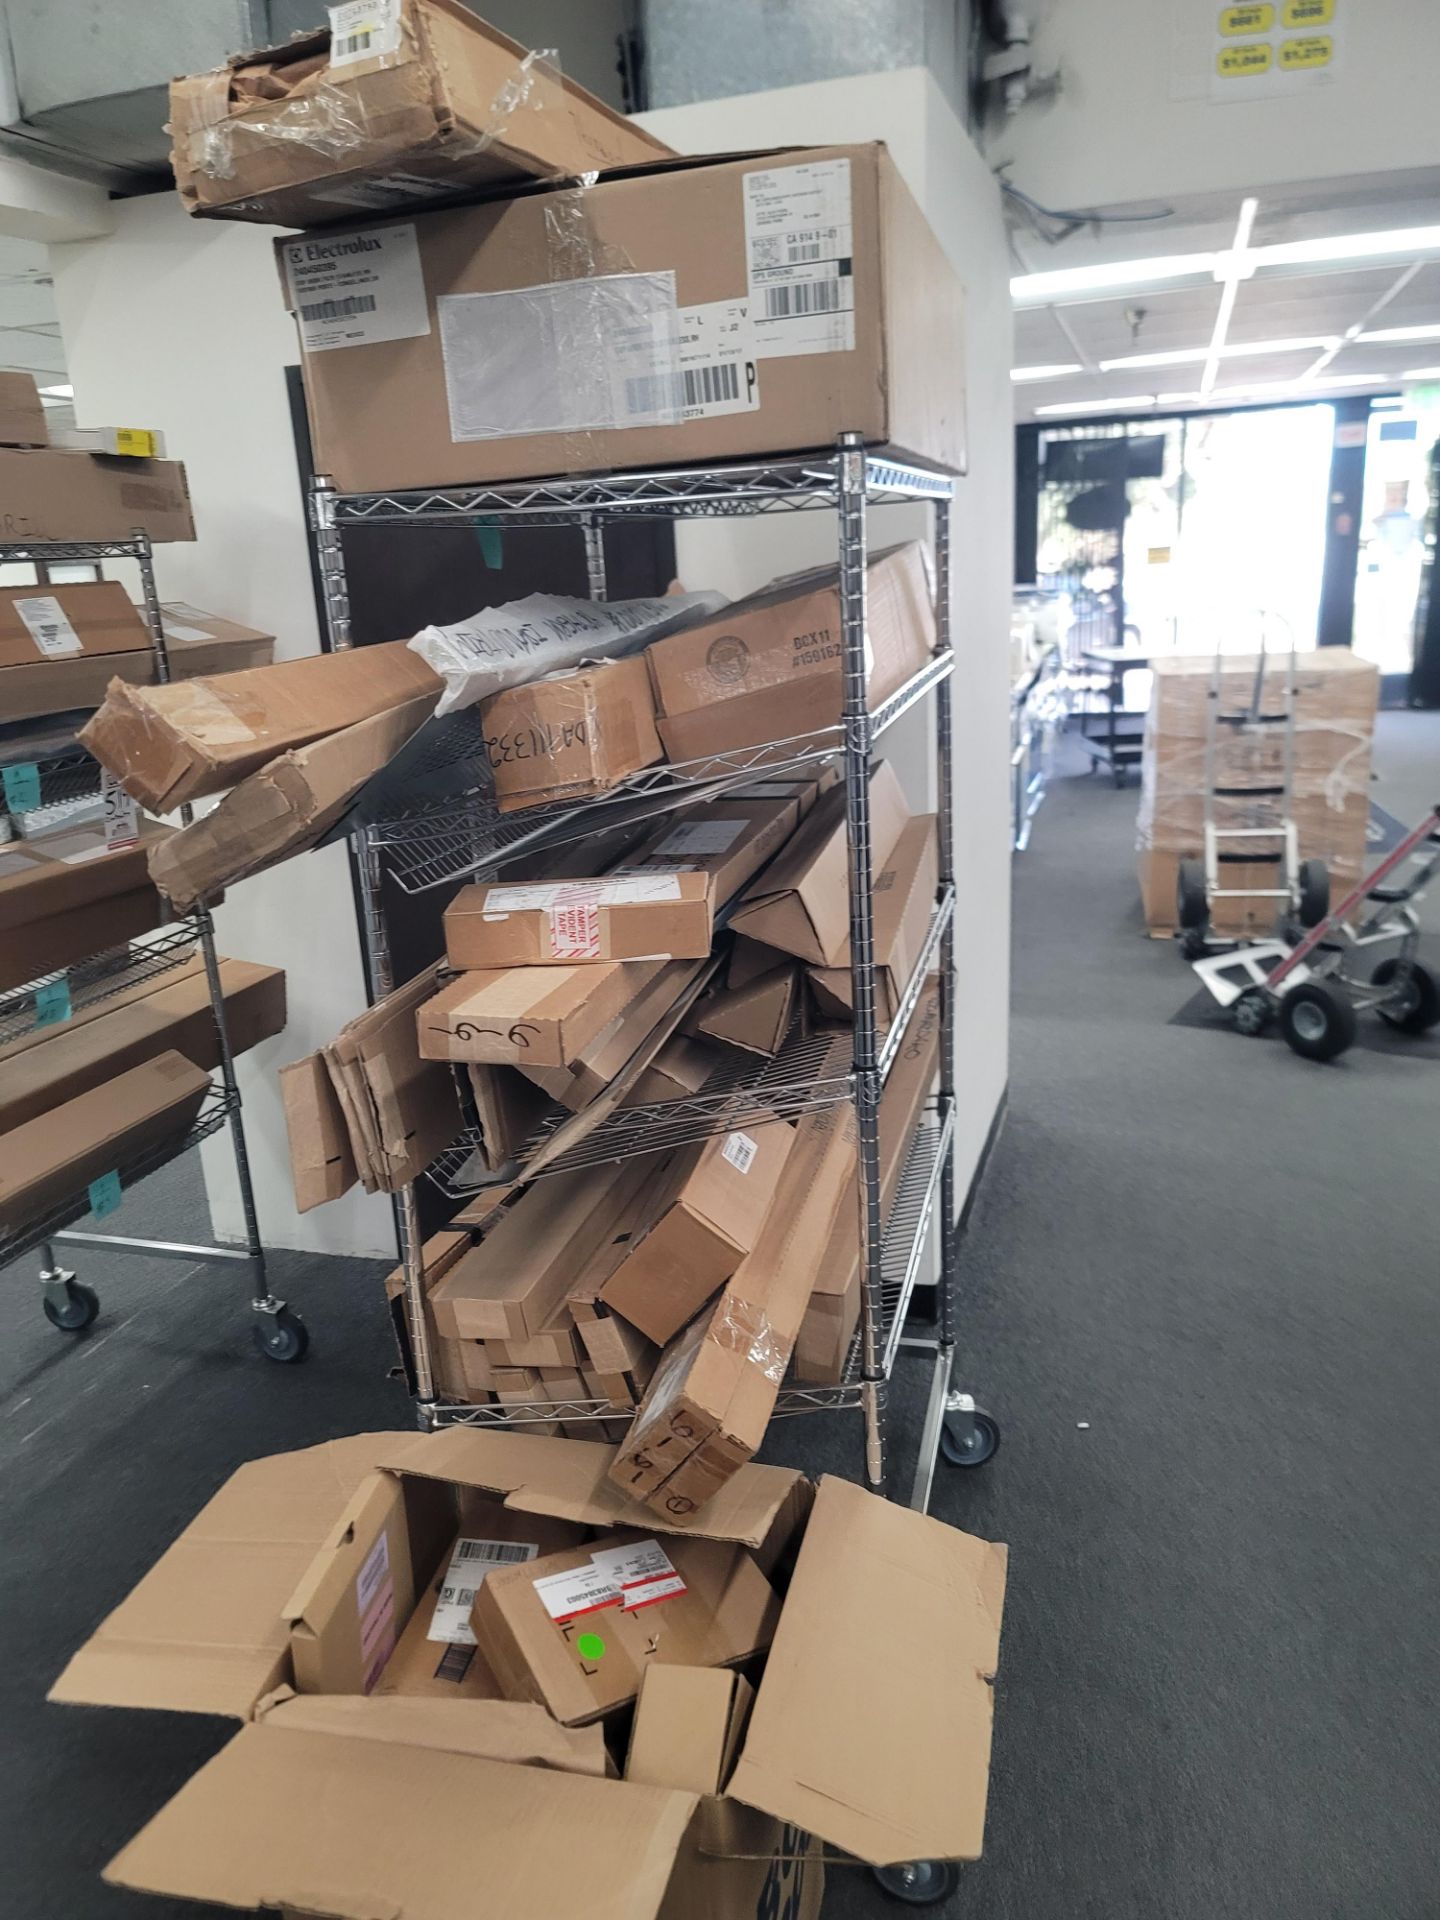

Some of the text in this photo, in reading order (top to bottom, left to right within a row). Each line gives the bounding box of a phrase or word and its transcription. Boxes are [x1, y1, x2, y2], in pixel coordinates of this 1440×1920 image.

[306, 236, 382, 261] Electrolux
[556, 912, 568, 936] TAPE
[566, 903, 577, 944] EVIDENT
[576, 904, 587, 944] TAMPER
